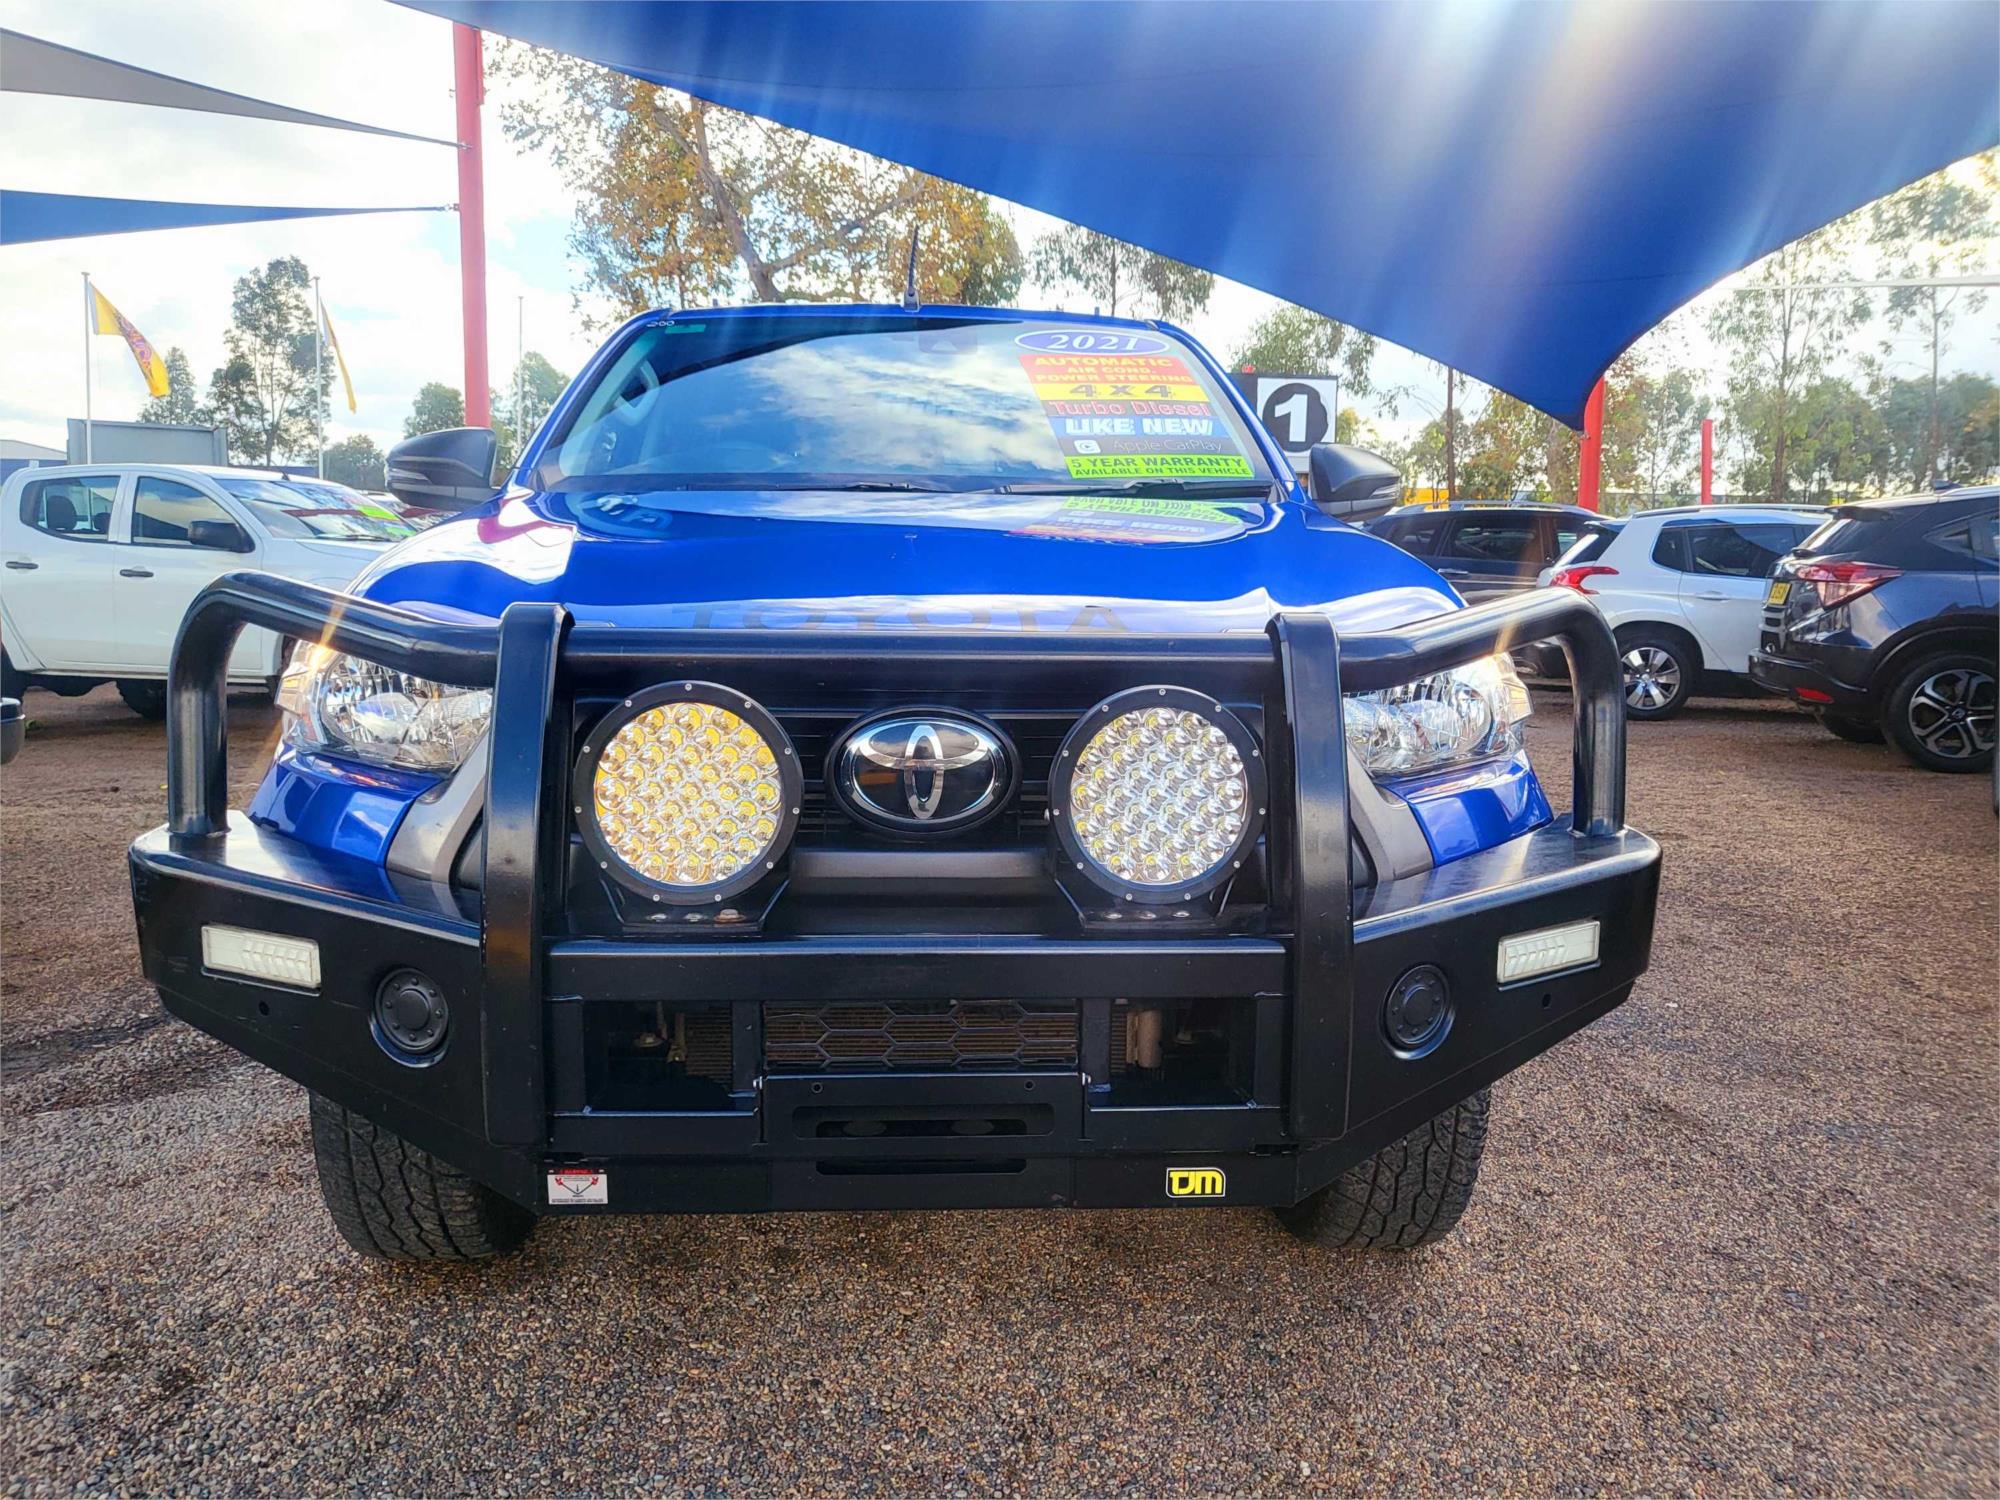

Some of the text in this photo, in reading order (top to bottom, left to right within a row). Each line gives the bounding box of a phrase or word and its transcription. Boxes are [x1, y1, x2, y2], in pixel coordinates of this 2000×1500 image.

[1047, 334, 1138, 350] 2021
[1035, 357, 1172, 367] AUTOMATIC
[1036, 374, 1192, 383] POWER STEERING
[1049, 401, 1210, 416] Turbo Diesel
[1275, 394, 1308, 442] 1
[1065, 418, 1212, 435] LIKE NEW
[1113, 440, 1222, 454] Apple CarPlay
[1072, 458, 1242, 468] 5 YEAR WARRANTY
[1075, 468, 1139, 476] AVAILABLE
[1198, 467, 1249, 475] VEHICLE
[1170, 1170, 1223, 1195] TJM
